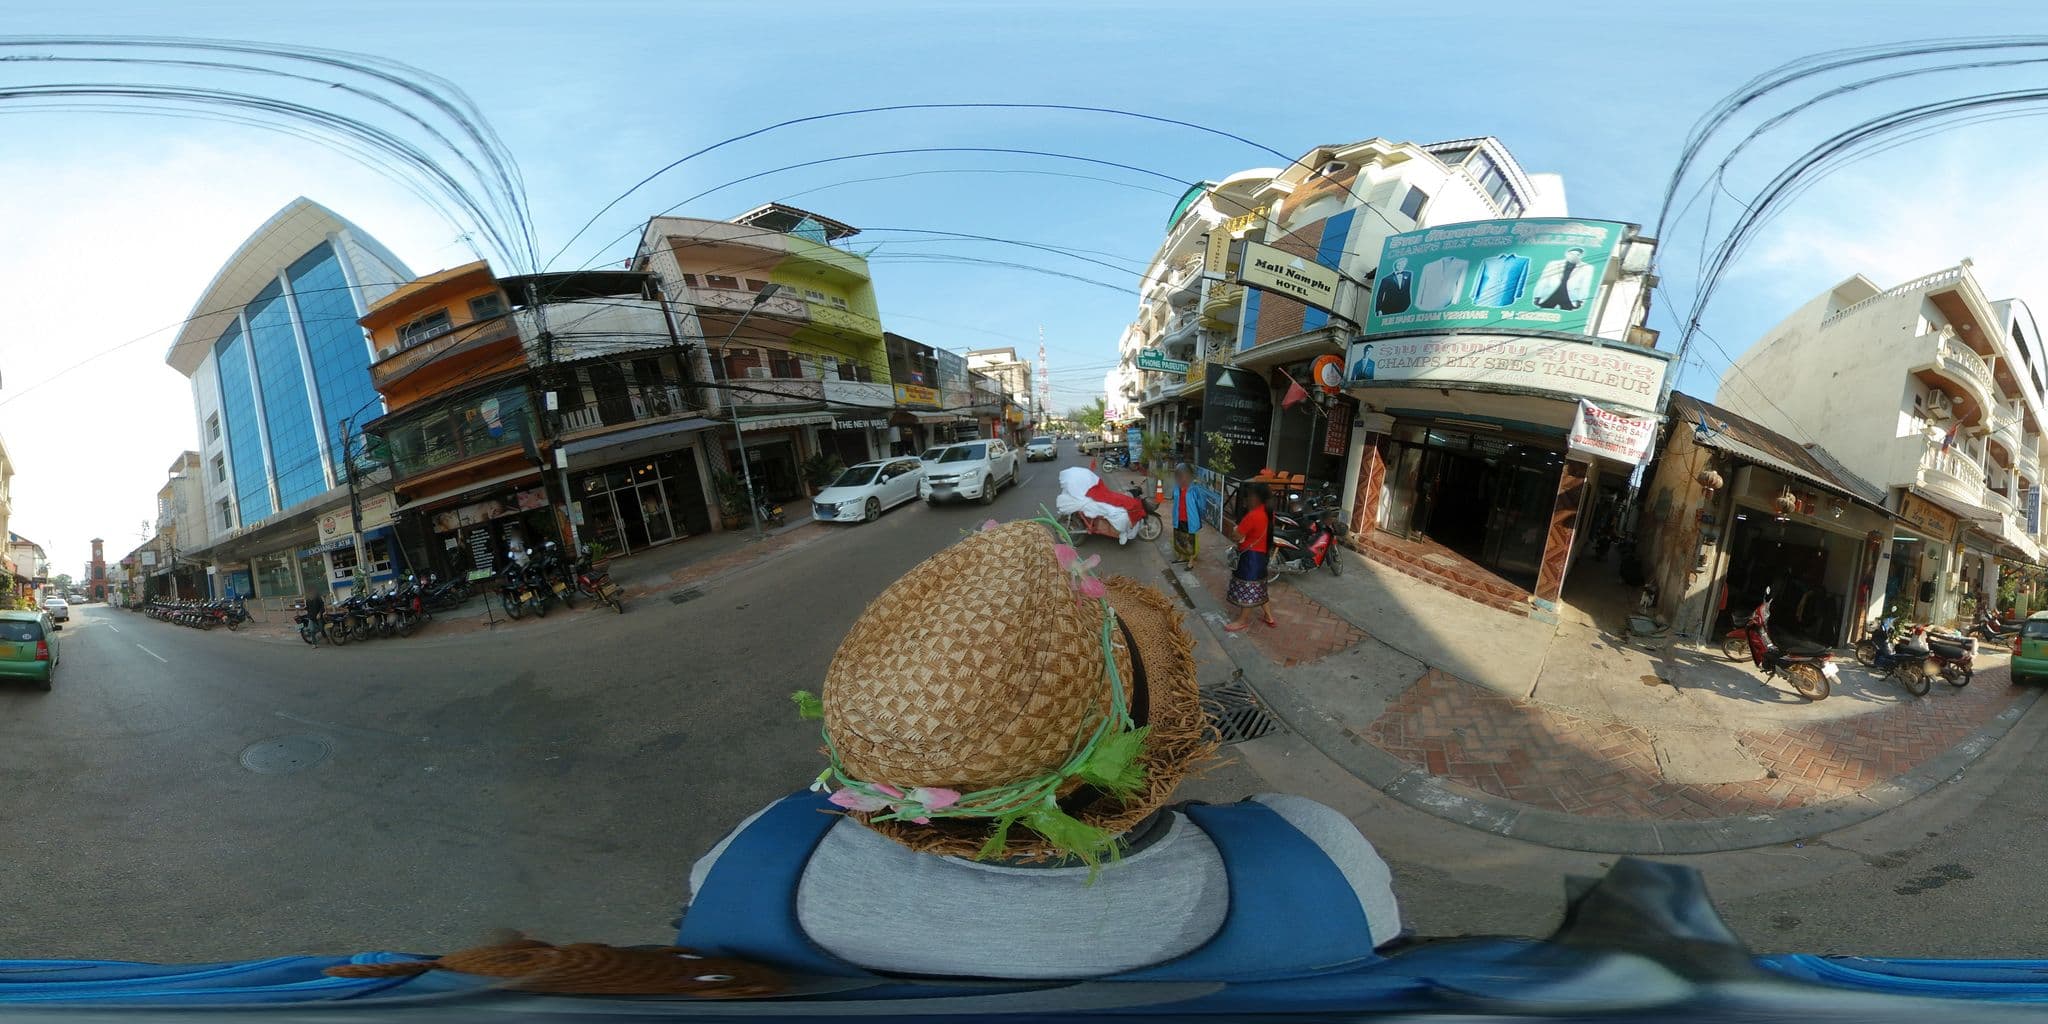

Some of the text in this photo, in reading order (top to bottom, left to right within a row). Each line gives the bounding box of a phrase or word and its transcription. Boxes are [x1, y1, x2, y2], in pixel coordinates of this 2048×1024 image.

[1276, 279, 1309, 297] HOTEL
[1286, 269, 1331, 293] Namphu
[1141, 358, 1161, 368] PHONE
[1377, 356, 1441, 369] CHAMPS
[1446, 356, 1481, 369] ELY
[1484, 357, 1536, 373] SEES
[1542, 362, 1651, 396] TAILLEUR
[838, 420, 853, 430] THE
[853, 419, 870, 428] NEW
[1610, 423, 1628, 434] FOR
